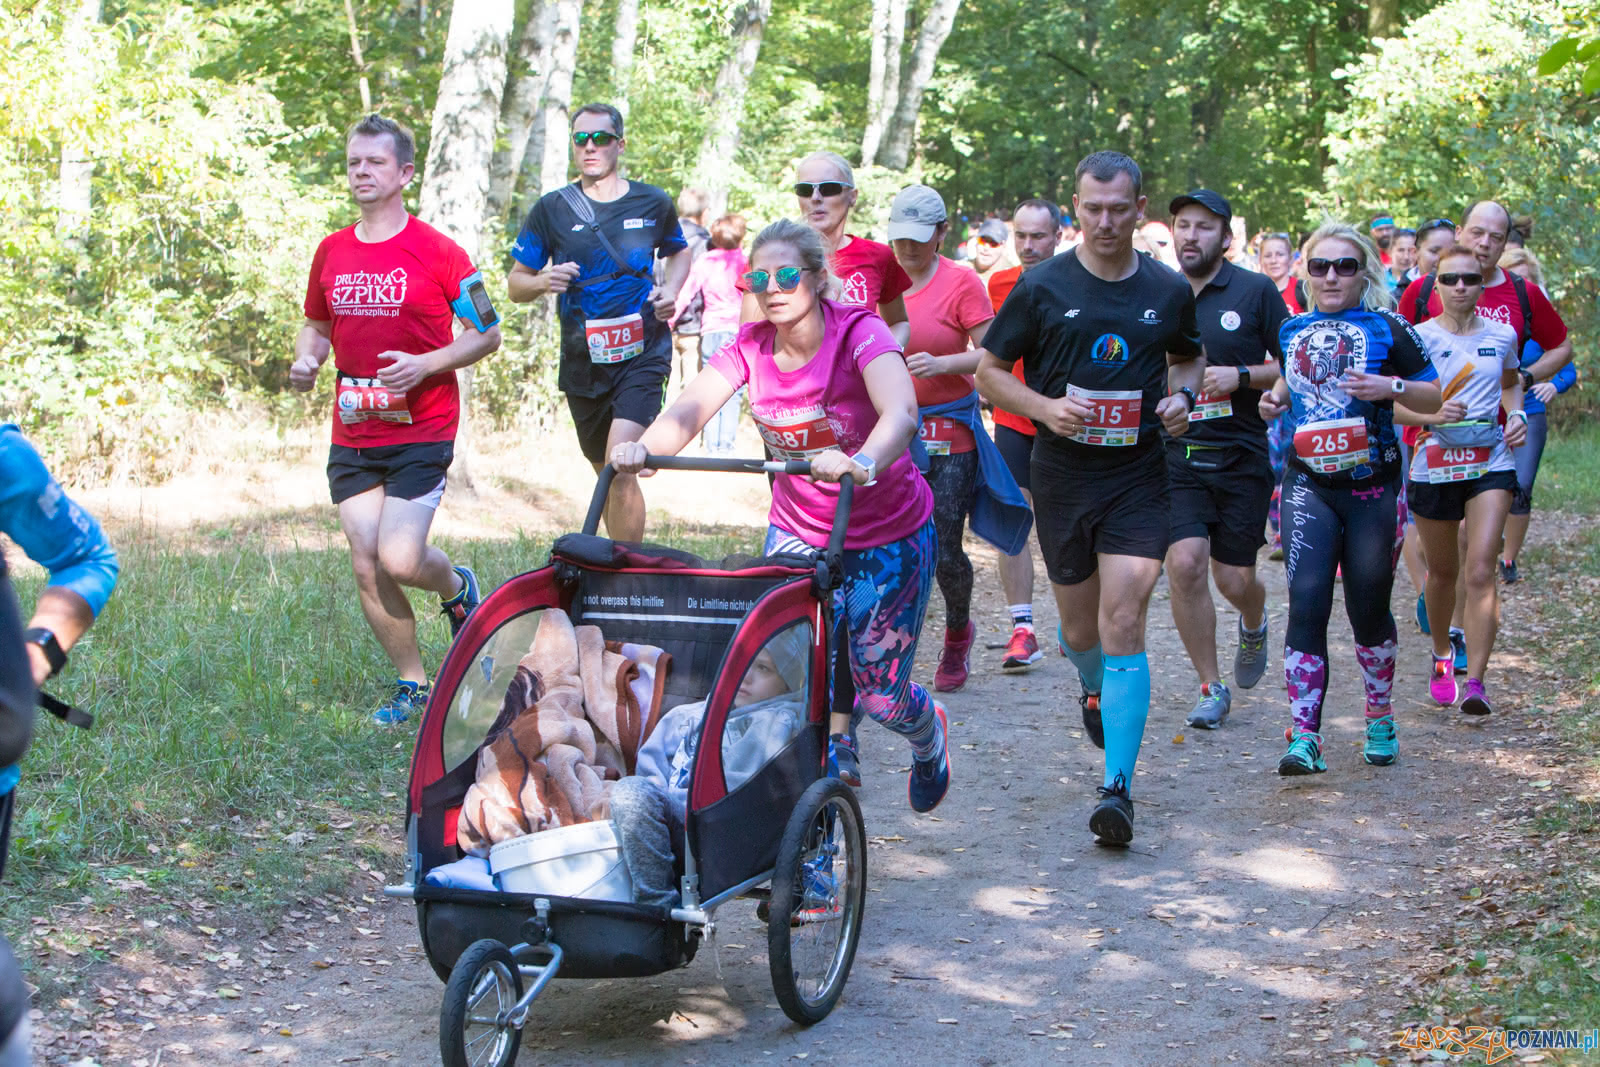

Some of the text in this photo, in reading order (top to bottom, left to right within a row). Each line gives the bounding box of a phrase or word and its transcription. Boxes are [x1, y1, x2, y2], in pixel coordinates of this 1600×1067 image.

[334, 270, 392, 286] DRUŻYNA
[331, 285, 407, 306] SZPIKU
[334, 308, 400, 317] www.darszpiku.pl
[1064, 309, 1080, 318] 4F
[602, 327, 631, 345] 178
[1351, 330, 1364, 359] TEAM
[357, 392, 389, 409] 113
[1312, 433, 1348, 453] 265
[1443, 447, 1476, 463] 405
[1293, 511, 1317, 527] to
[587, 595, 599, 605] not
[600, 595, 628, 608] overpass
[629, 594, 641, 606] this
[642, 595, 665, 607] limitline
[687, 597, 698, 609] Die
[700, 597, 729, 610] Limitlinie
[729, 599, 745, 611] nicht
